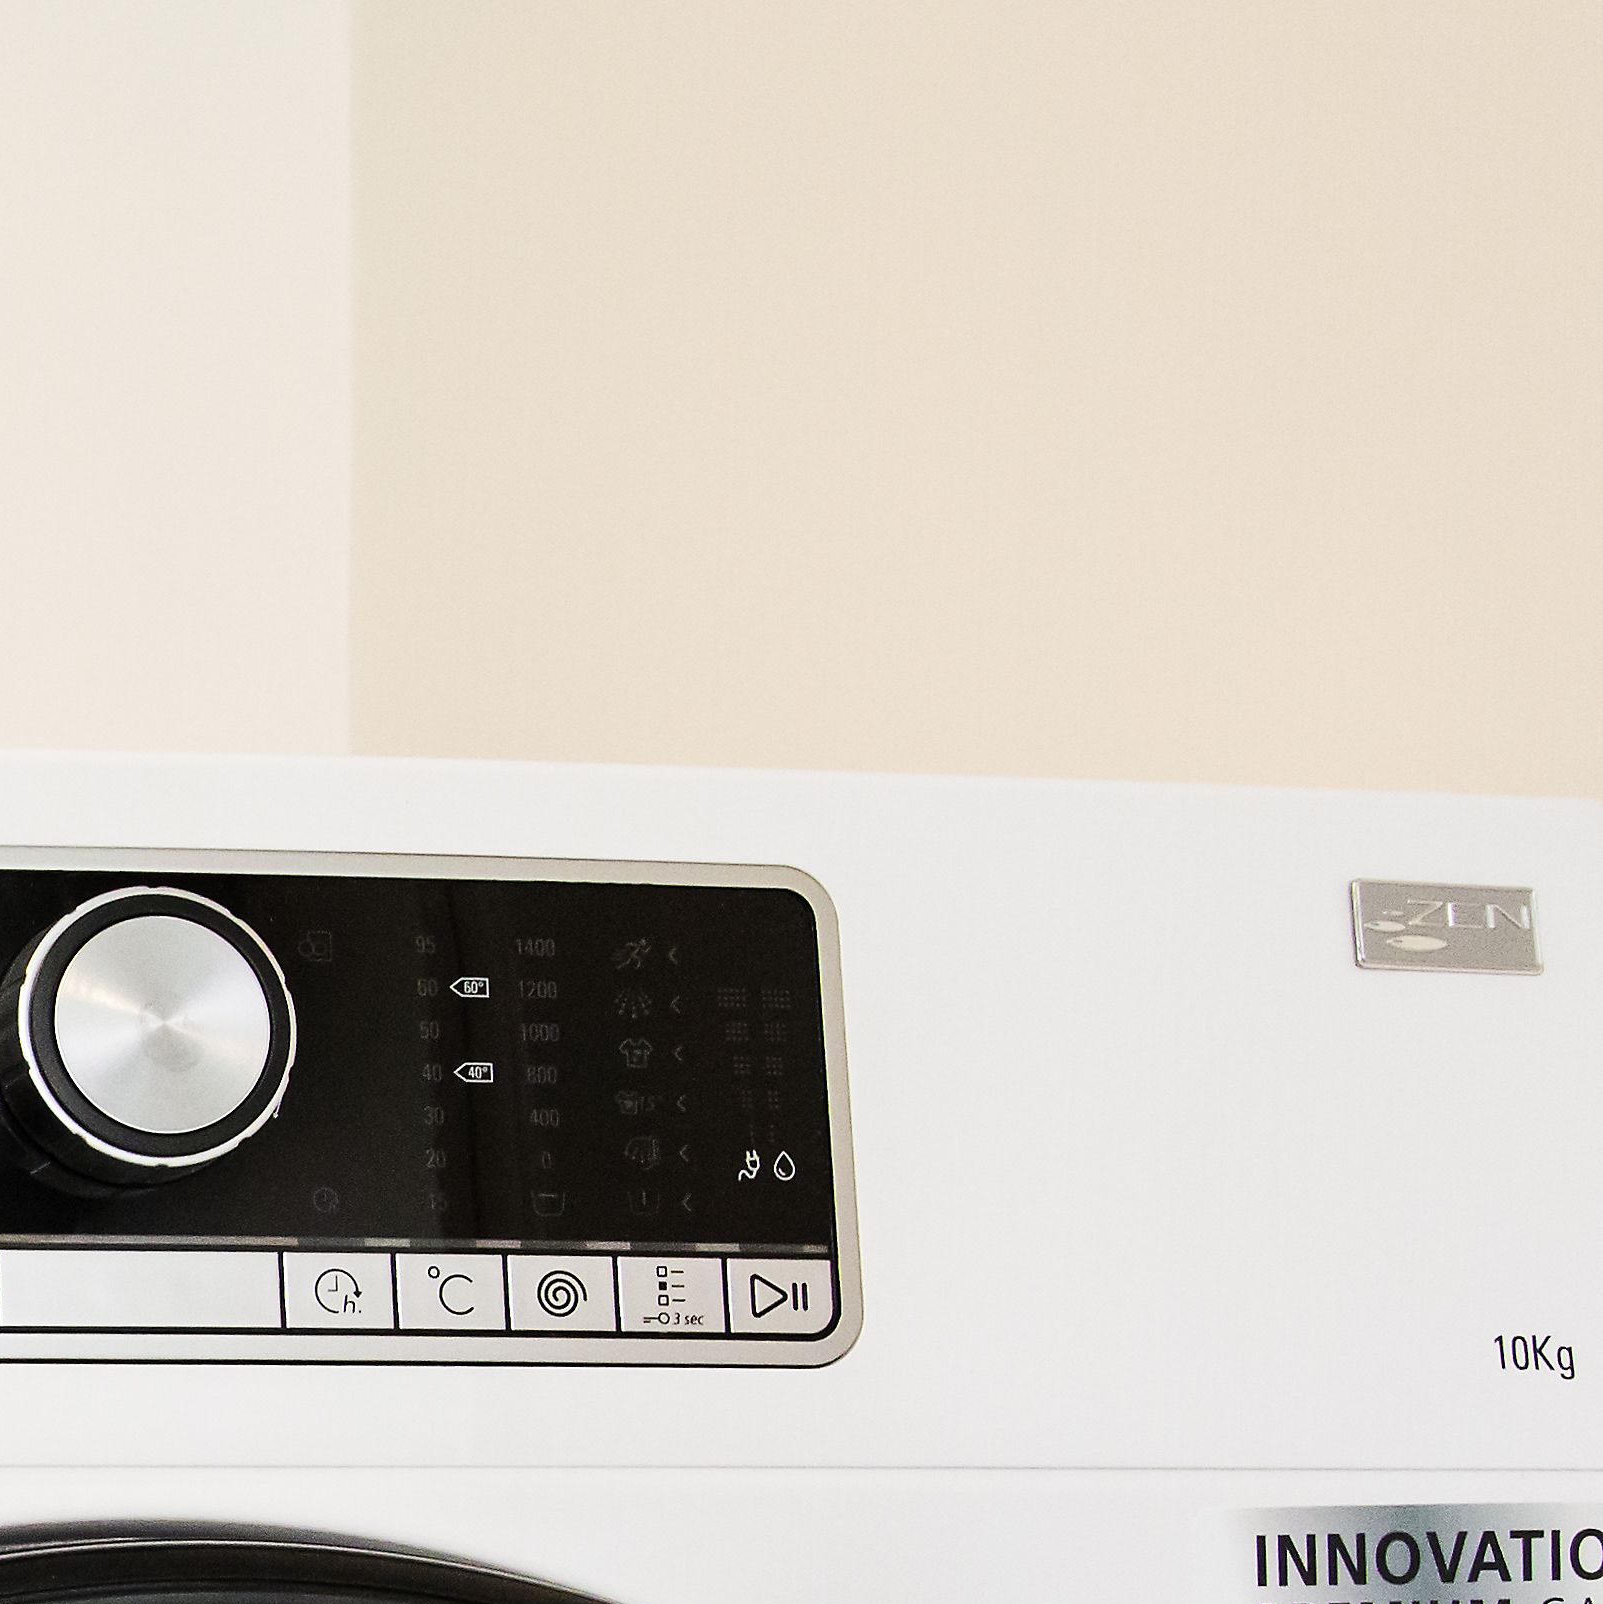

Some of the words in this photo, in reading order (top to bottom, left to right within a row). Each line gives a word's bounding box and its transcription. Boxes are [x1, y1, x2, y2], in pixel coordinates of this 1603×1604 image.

[1407, 899, 1531, 929] ZEN
[464, 980, 484, 994] 60°
[468, 1065, 489, 1079] 40°
[673, 1313, 681, 1325] 3
[684, 1314, 705, 1326] sec
[1494, 1335, 1575, 1379] 10Kg
